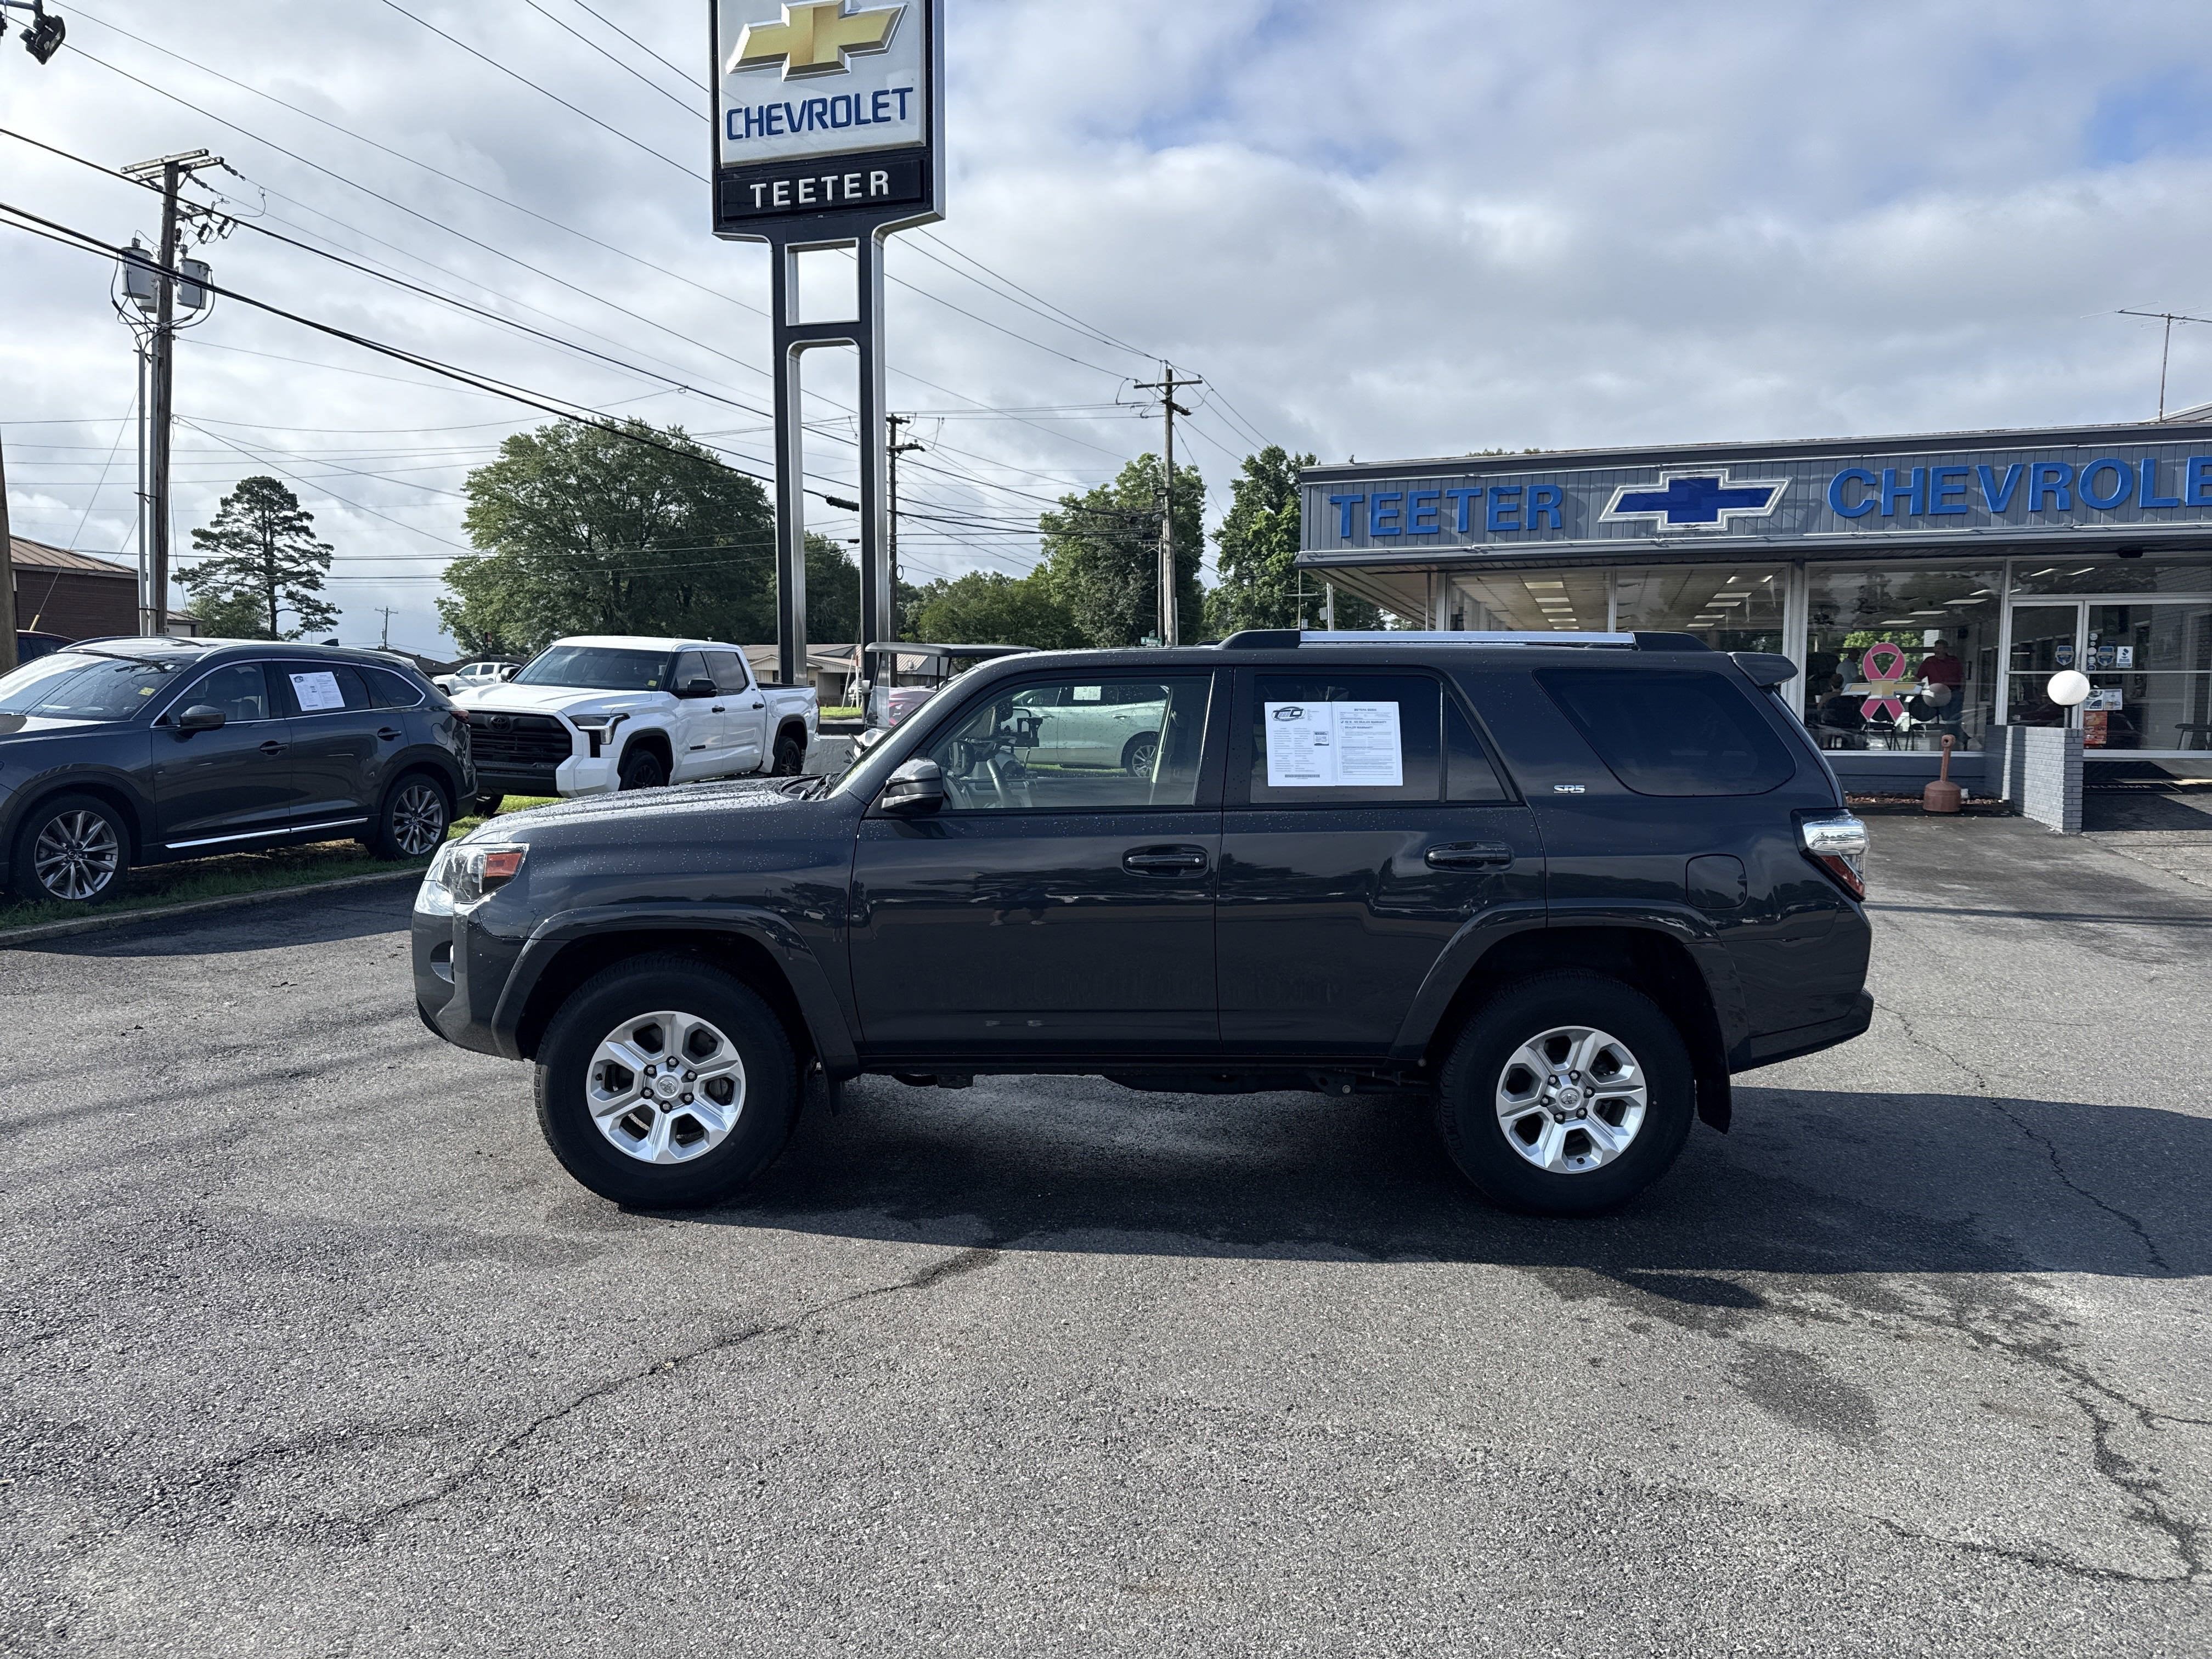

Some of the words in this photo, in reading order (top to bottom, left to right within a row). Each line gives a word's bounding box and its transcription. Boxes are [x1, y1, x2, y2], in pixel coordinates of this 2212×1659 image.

[726, 86, 913, 140] CHEVROLET
[749, 170, 890, 210] TEETER
[1329, 484, 1563, 538] TEETER
[1827, 455, 2212, 518] CHEVROLE
[1553, 785, 1585, 794] SR5
